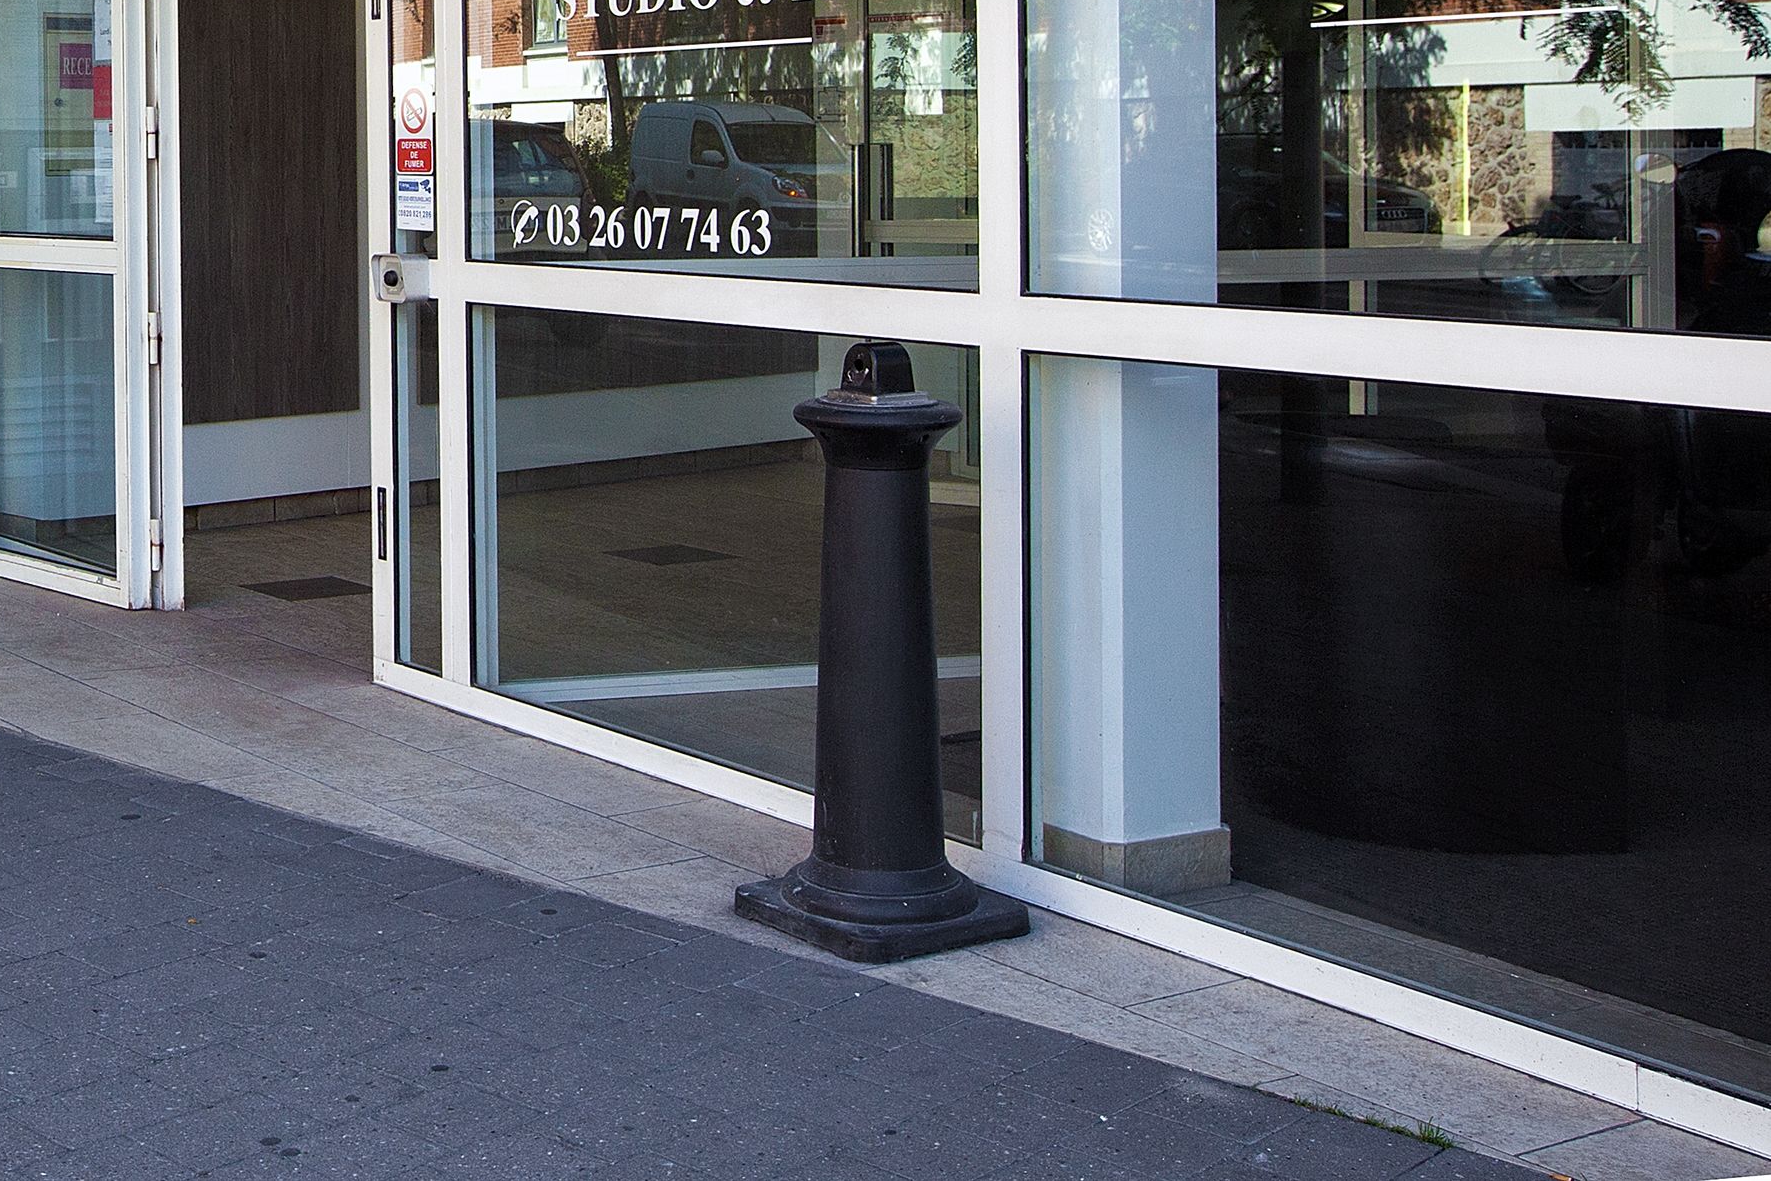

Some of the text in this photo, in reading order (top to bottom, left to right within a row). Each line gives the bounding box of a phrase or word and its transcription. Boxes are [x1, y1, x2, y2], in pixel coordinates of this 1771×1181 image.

[401, 141, 428, 149] DEFENSE
[410, 151, 418, 159] DE
[404, 160, 424, 168] FUMER
[546, 204, 772, 256] 03 26 07 74 63
